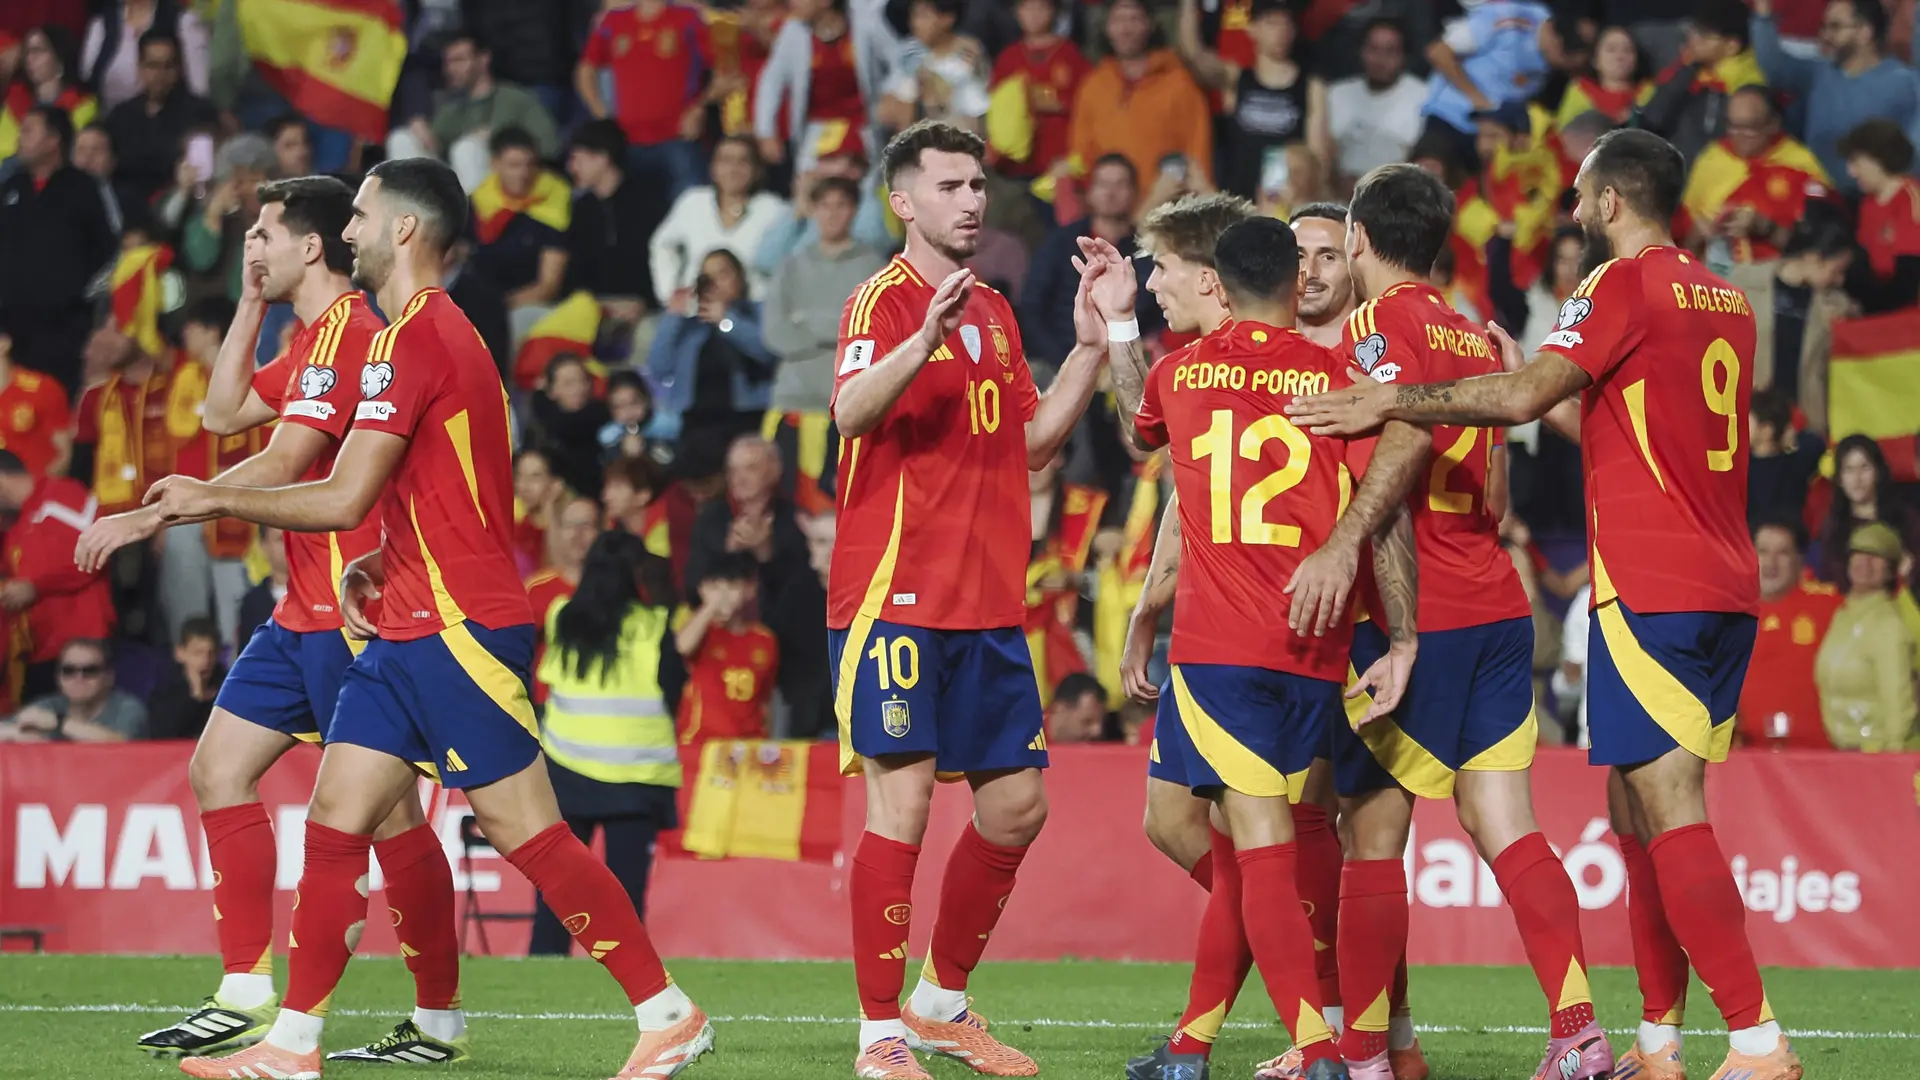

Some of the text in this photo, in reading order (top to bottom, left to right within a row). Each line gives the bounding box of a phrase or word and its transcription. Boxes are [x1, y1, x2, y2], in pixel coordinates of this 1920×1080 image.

[967, 378, 1000, 435] 10
[1173, 362, 1330, 397] PEDRO PORRO
[1701, 337, 1740, 471] 9
[1191, 409, 1311, 548] 12
[868, 635, 920, 690] 10
[14, 803, 501, 891] MAE
[1730, 853, 1863, 923] iajes
